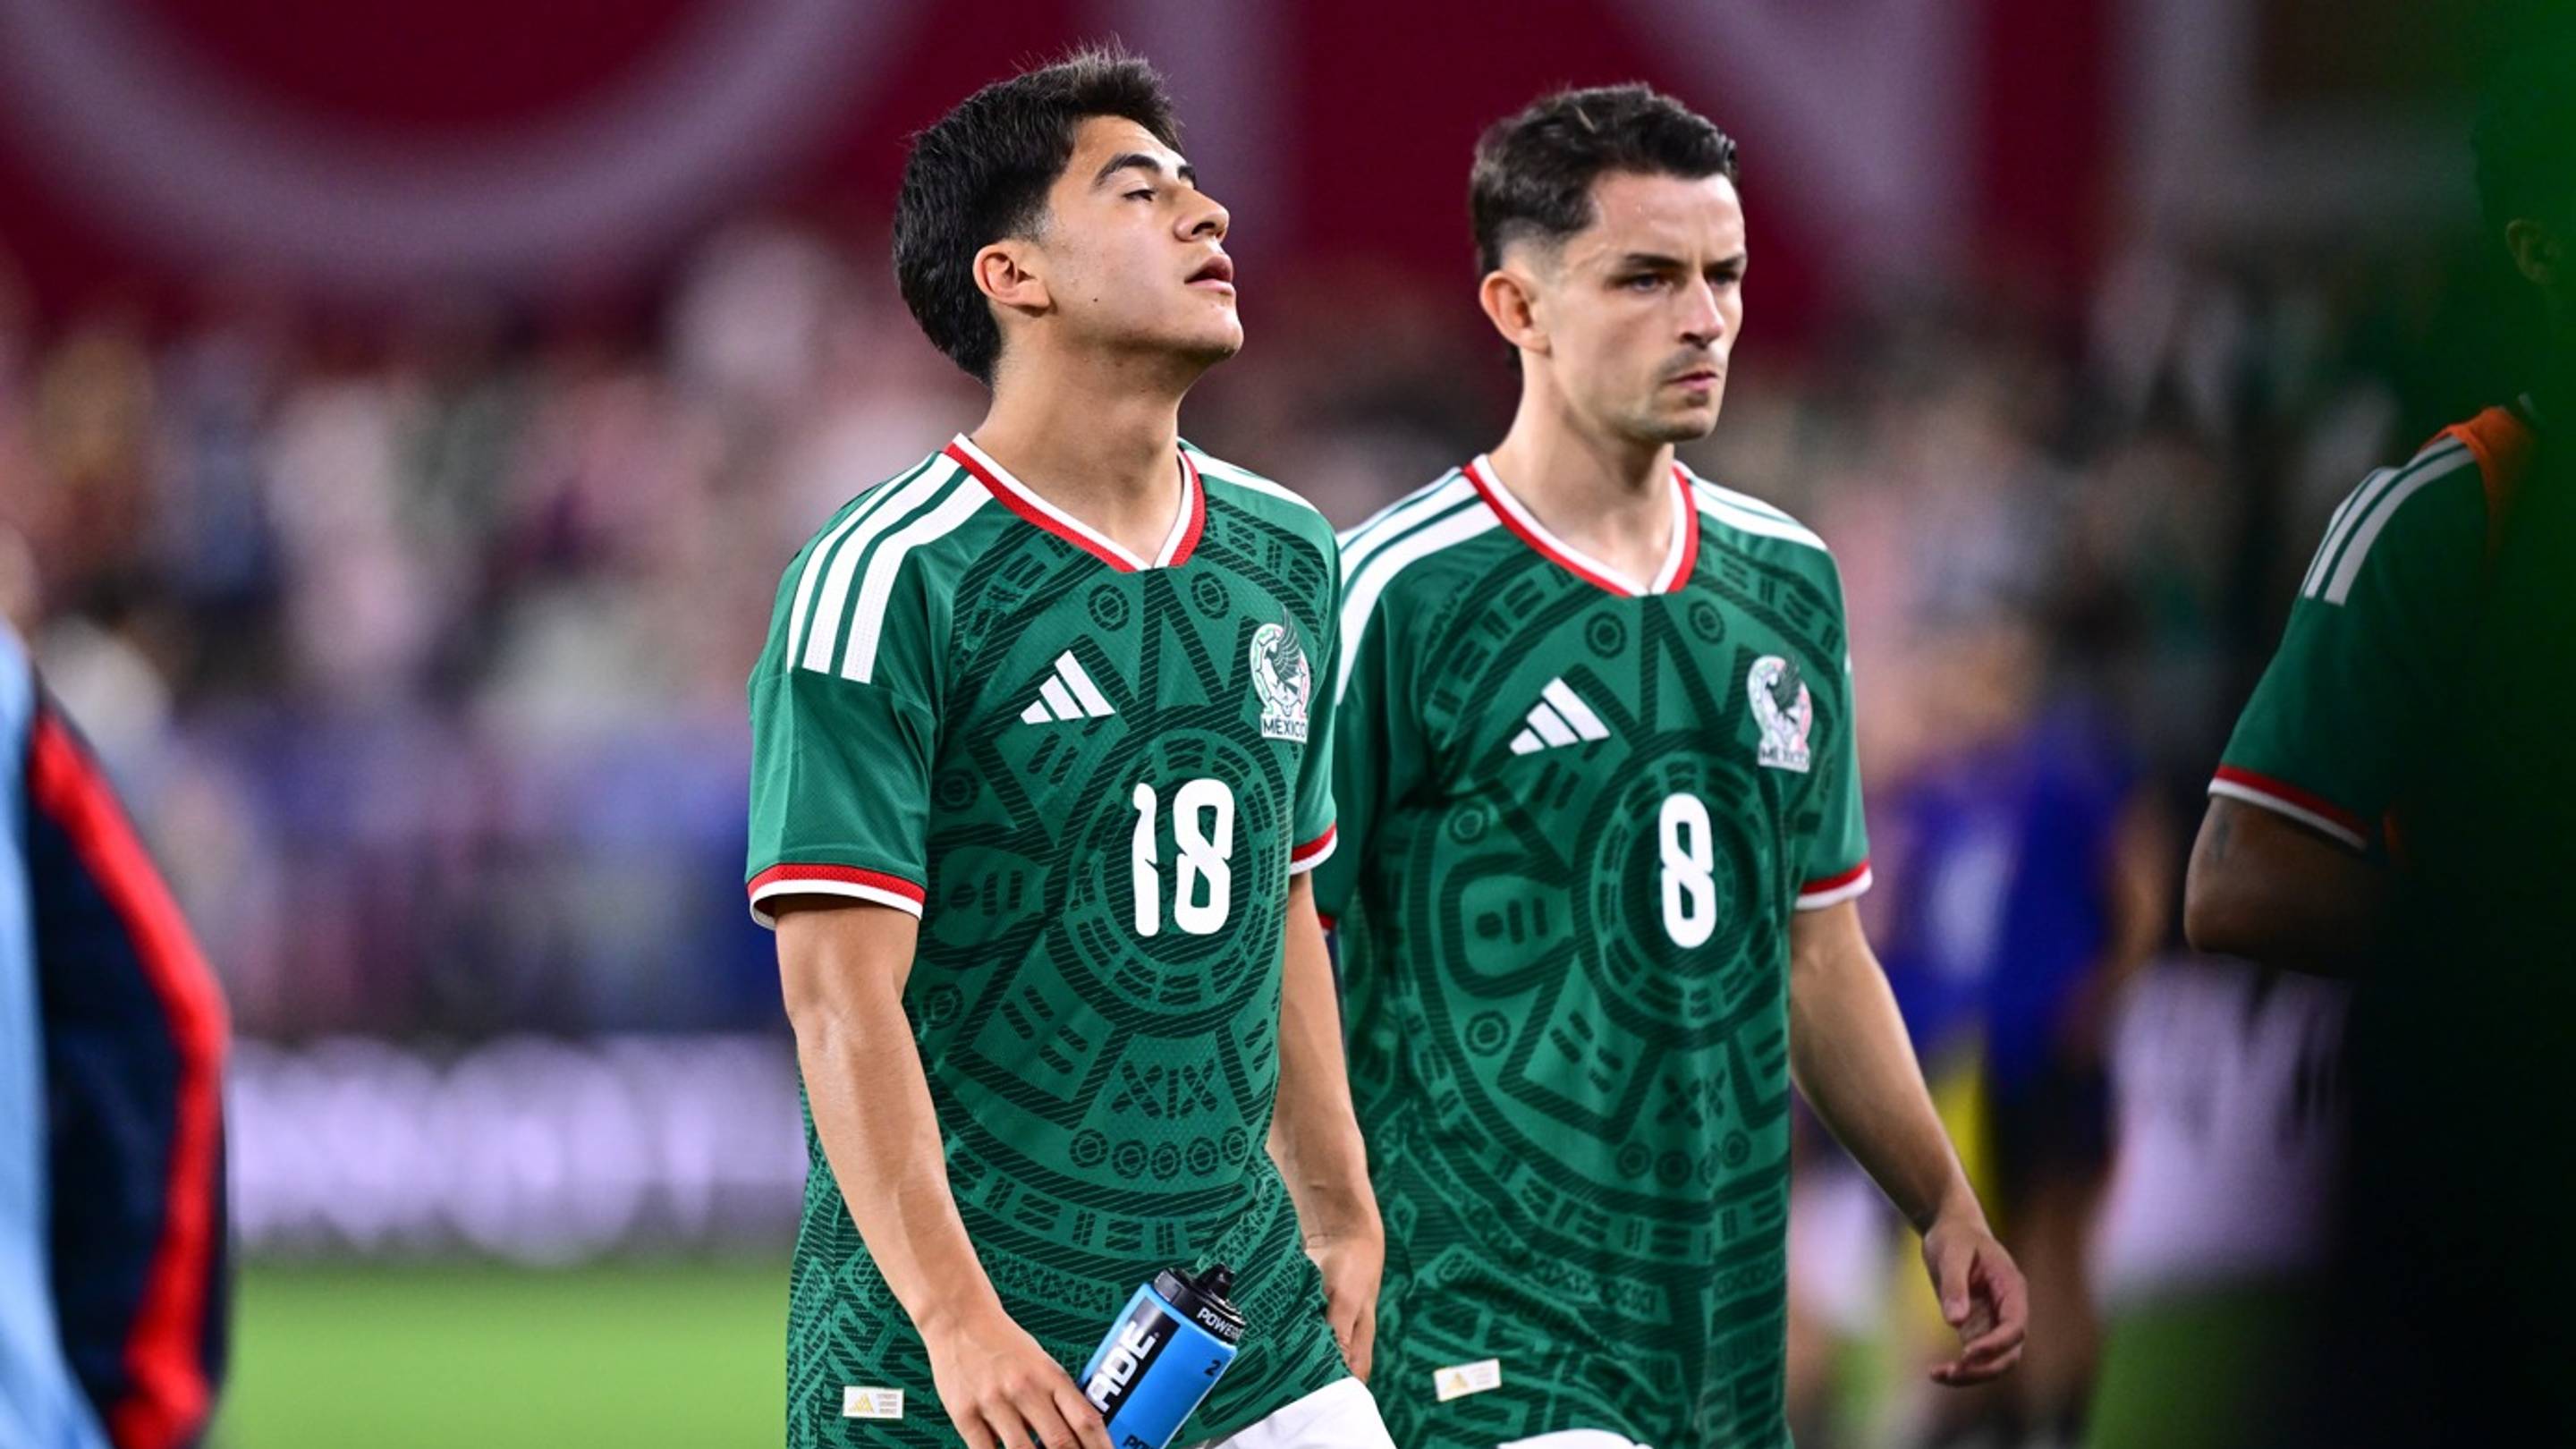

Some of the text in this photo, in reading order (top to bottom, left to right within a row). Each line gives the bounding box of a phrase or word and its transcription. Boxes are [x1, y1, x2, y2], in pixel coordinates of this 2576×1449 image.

[1133, 779, 1234, 936] 18
[1659, 792, 1716, 948] 8
[1204, 1359, 1222, 1377] 2
